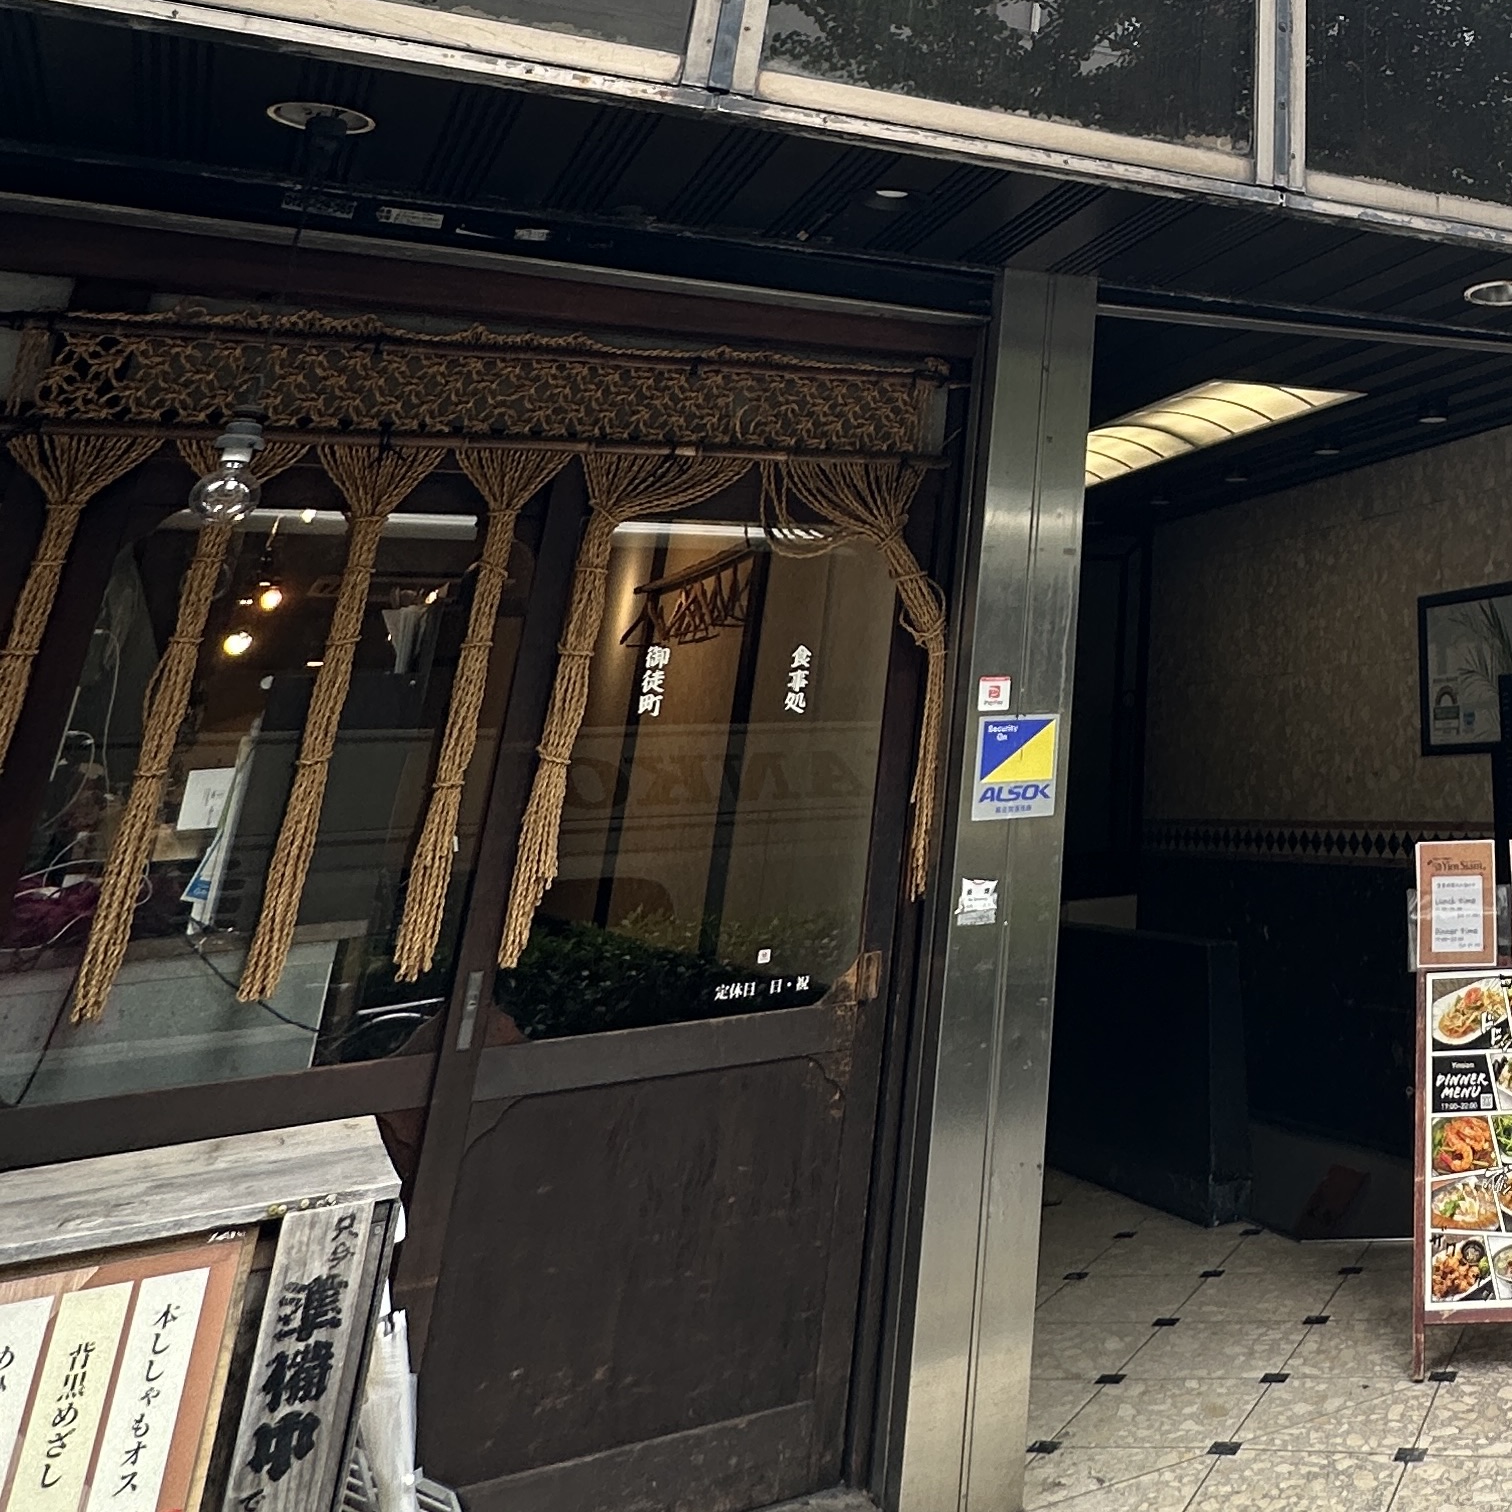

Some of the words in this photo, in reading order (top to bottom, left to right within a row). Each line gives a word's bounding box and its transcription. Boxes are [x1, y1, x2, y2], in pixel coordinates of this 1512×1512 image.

[637, 645, 671, 718] 御徒町
[784, 644, 813, 715] 食事処
[987, 723, 1019, 734] Security
[978, 782, 1051, 804] ALSOK
[714, 980, 757, 1002] 定休日
[1435, 1071, 1490, 1088] DINNER
[1440, 1085, 1482, 1100] MENU
[111, 1303, 180, 1498] 本ししゃもオス
[41, 1340, 97, 1489] 背黒めざし
